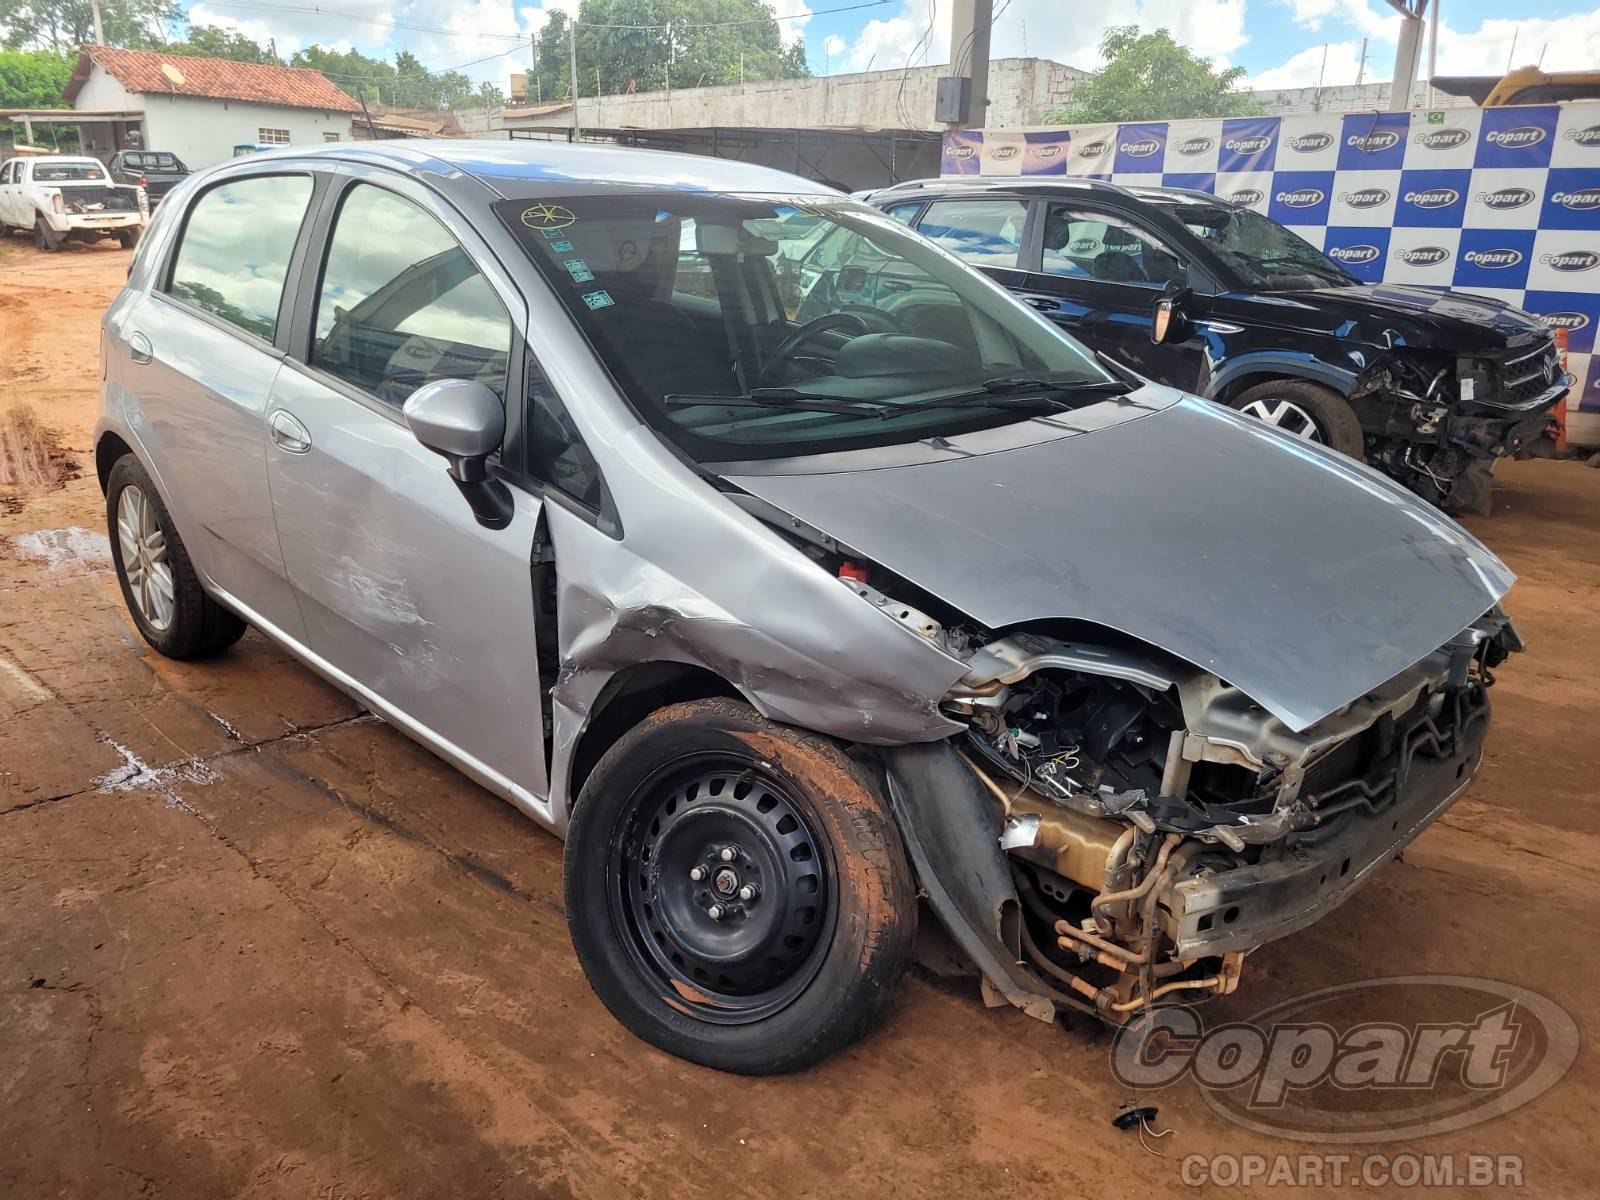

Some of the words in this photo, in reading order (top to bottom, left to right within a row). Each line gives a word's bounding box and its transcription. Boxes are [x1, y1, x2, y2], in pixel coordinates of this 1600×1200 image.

[1284, 136, 1326, 149] Copart
[1414, 132, 1461, 147] Copart
[1486, 129, 1537, 143] Copart
[1120, 140, 1155, 153] Copart
[1172, 138, 1209, 152] Copart
[1225, 137, 1265, 151] Copart
[1276, 191, 1320, 204] Copart
[1337, 191, 1383, 205] Copart
[1404, 191, 1452, 205] Copart
[1474, 191, 1526, 206] Copart
[1551, 191, 1600, 206] Copar
[1329, 247, 1374, 259] Copart
[1394, 248, 1441, 261] Copart
[1464, 251, 1516, 264] Copart
[1540, 253, 1593, 267] Copart
